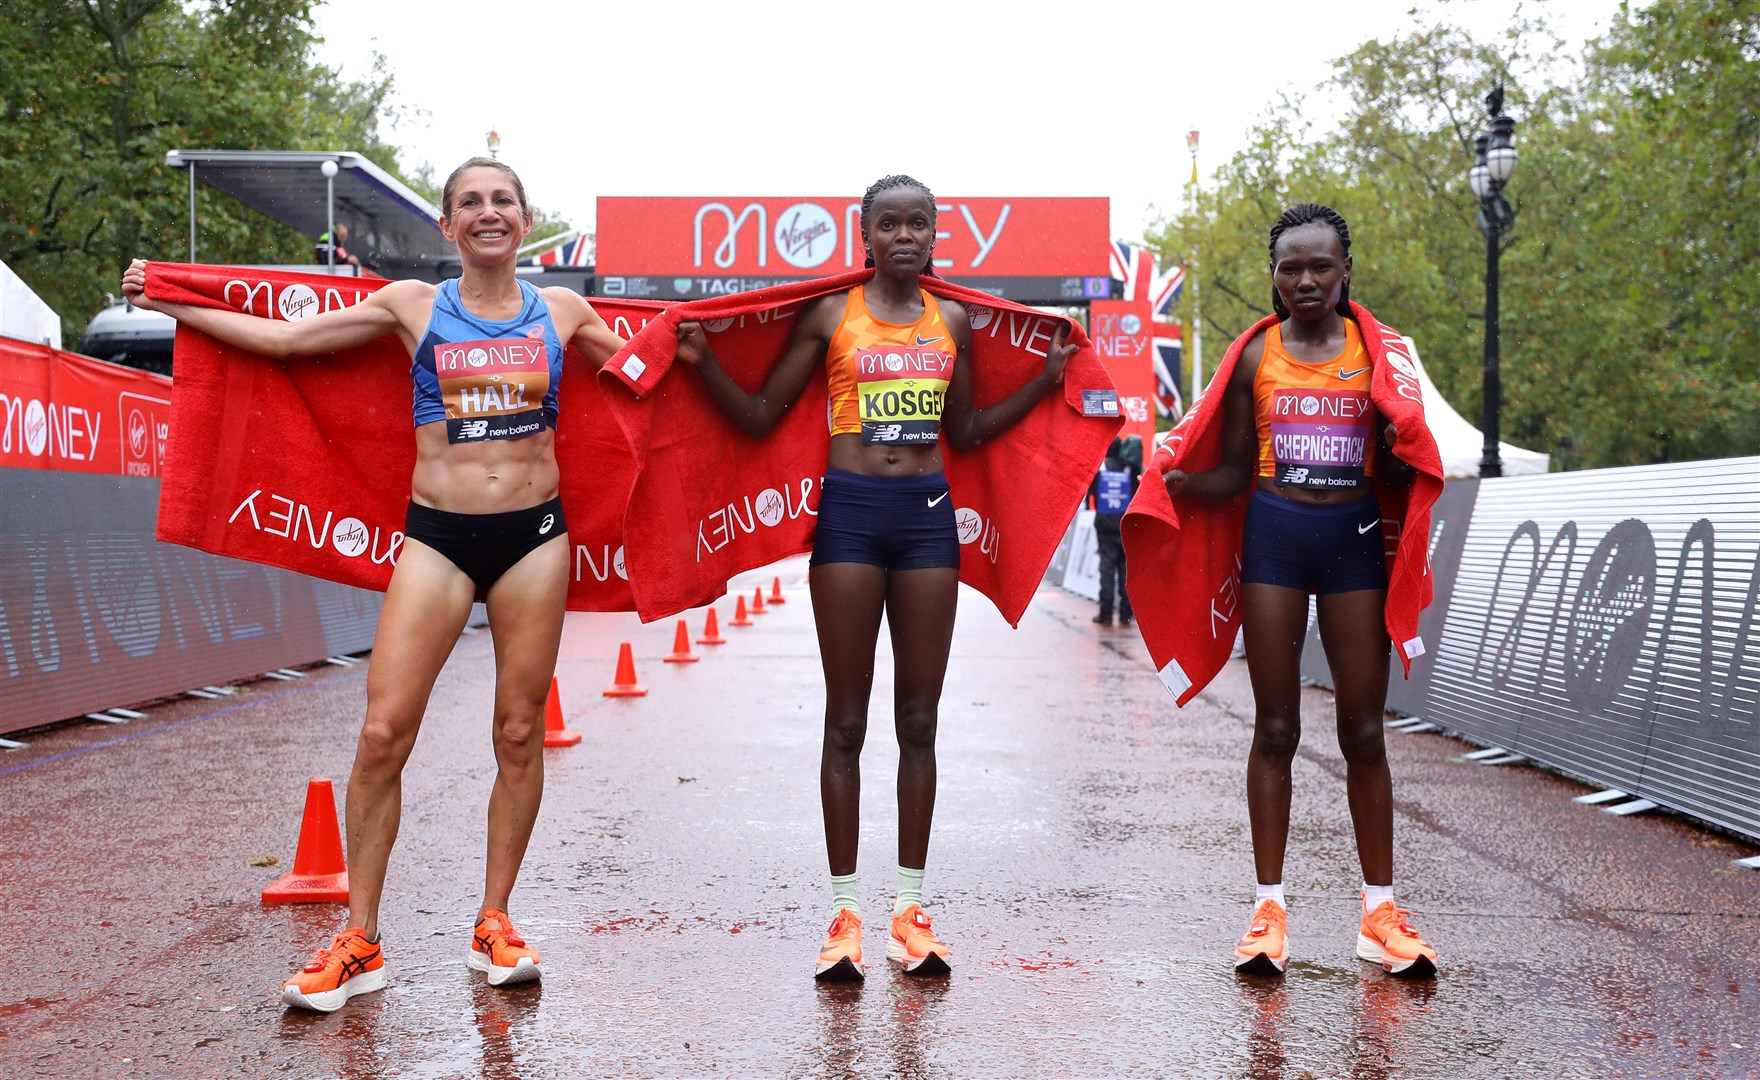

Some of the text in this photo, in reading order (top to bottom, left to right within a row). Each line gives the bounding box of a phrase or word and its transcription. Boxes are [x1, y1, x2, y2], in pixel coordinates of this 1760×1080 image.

[780, 211, 831, 258] Virgin
[282, 289, 315, 318] Virgin
[441, 345, 541, 371] MONEY
[861, 352, 949, 374] MONEY
[460, 383, 529, 414] HALL
[1275, 395, 1369, 418] MONEY
[489, 428, 508, 437] new
[509, 422, 540, 436] balance
[902, 432, 921, 440] new
[1275, 433, 1365, 463] CHEPNGETICH
[1328, 477, 1357, 487] balance
[336, 523, 366, 552] Virgin
